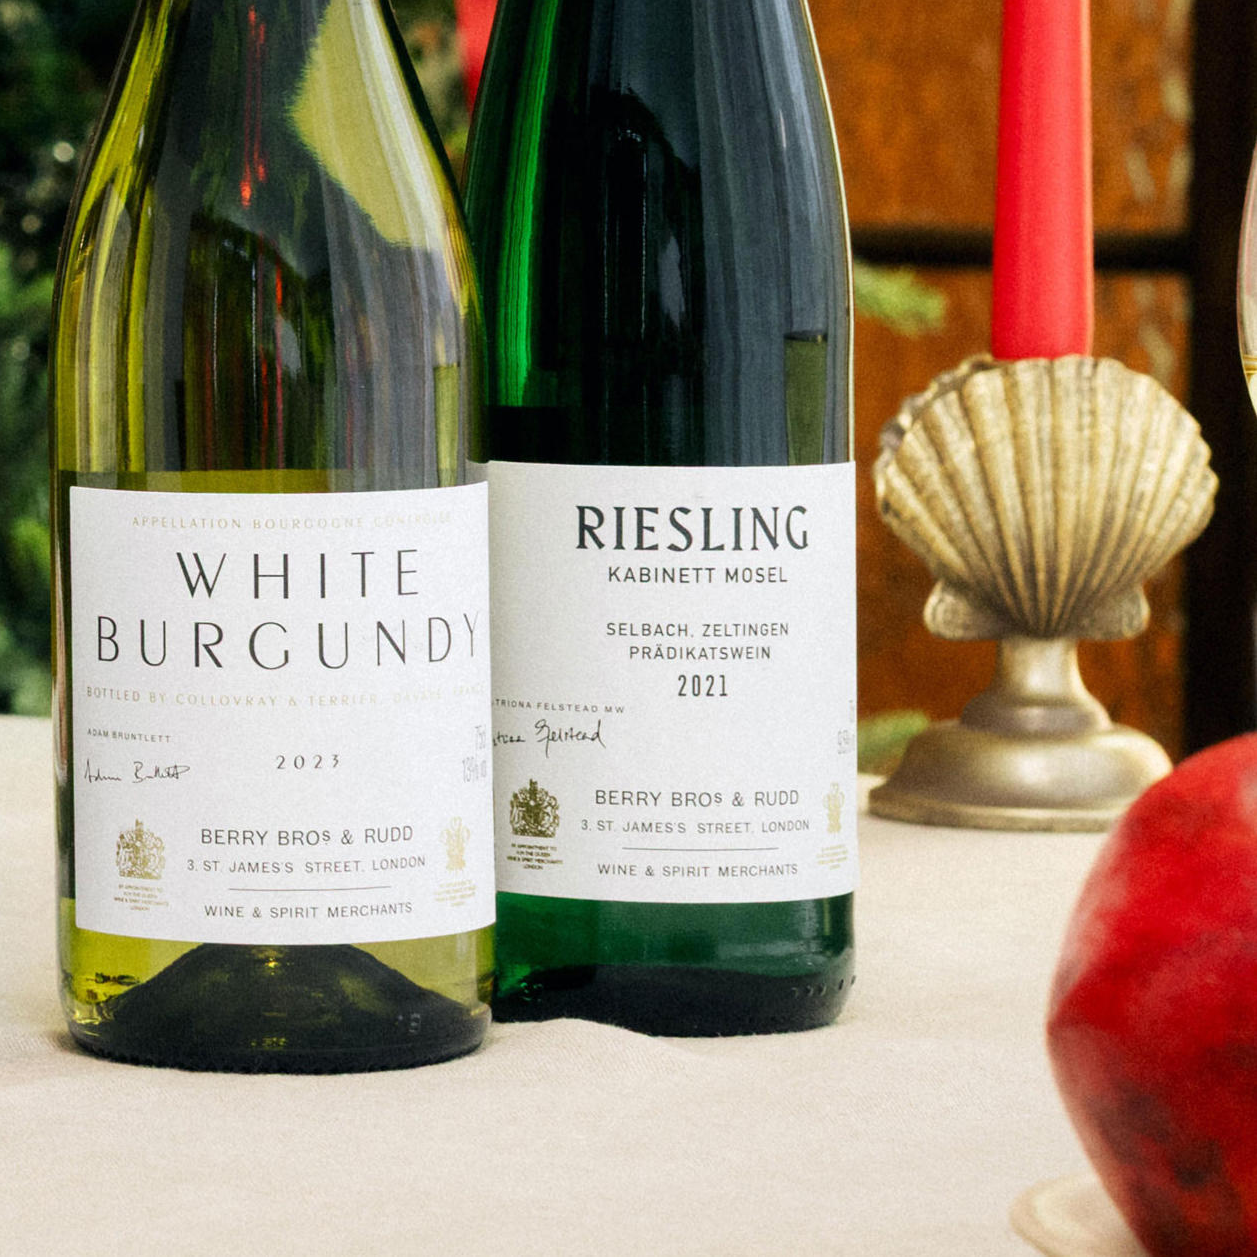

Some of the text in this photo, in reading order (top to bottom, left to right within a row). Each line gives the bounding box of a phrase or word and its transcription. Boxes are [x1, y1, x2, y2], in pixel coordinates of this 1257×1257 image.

[131, 516, 242, 530] APPELLATION
[575, 504, 809, 552] RIESLING
[175, 549, 419, 600] WHITE
[608, 566, 788, 584] KABINETT MOSEL
[702, 622, 789, 637] ZELTINGEN
[96, 610, 480, 670] BURGUNDY
[629, 642, 772, 660] PRÄDIKATSWEIN
[677, 674, 729, 697] 2021
[86, 686, 141, 703] BOTTLED
[149, 691, 167, 705] BY
[492, 698, 625, 714] TRIONA FELSTEAD MW
[275, 754, 341, 772] 2023
[595, 789, 662, 807] BERRY
[731, 791, 745, 807] &
[754, 789, 799, 807] RUDD
[201, 828, 268, 846] BERRY
[340, 829, 354, 846] &
[364, 825, 413, 844] RUDD
[622, 820, 687, 834] JAMES'S
[762, 819, 810, 833] LONDON
[228, 859, 294, 874] JAMES'S
[372, 856, 427, 871] LONDON
[597, 863, 798, 878] WINE & SPIRIT MERCHANTS
[204, 901, 413, 919] WINE & SPIRIT MERCHANTS
